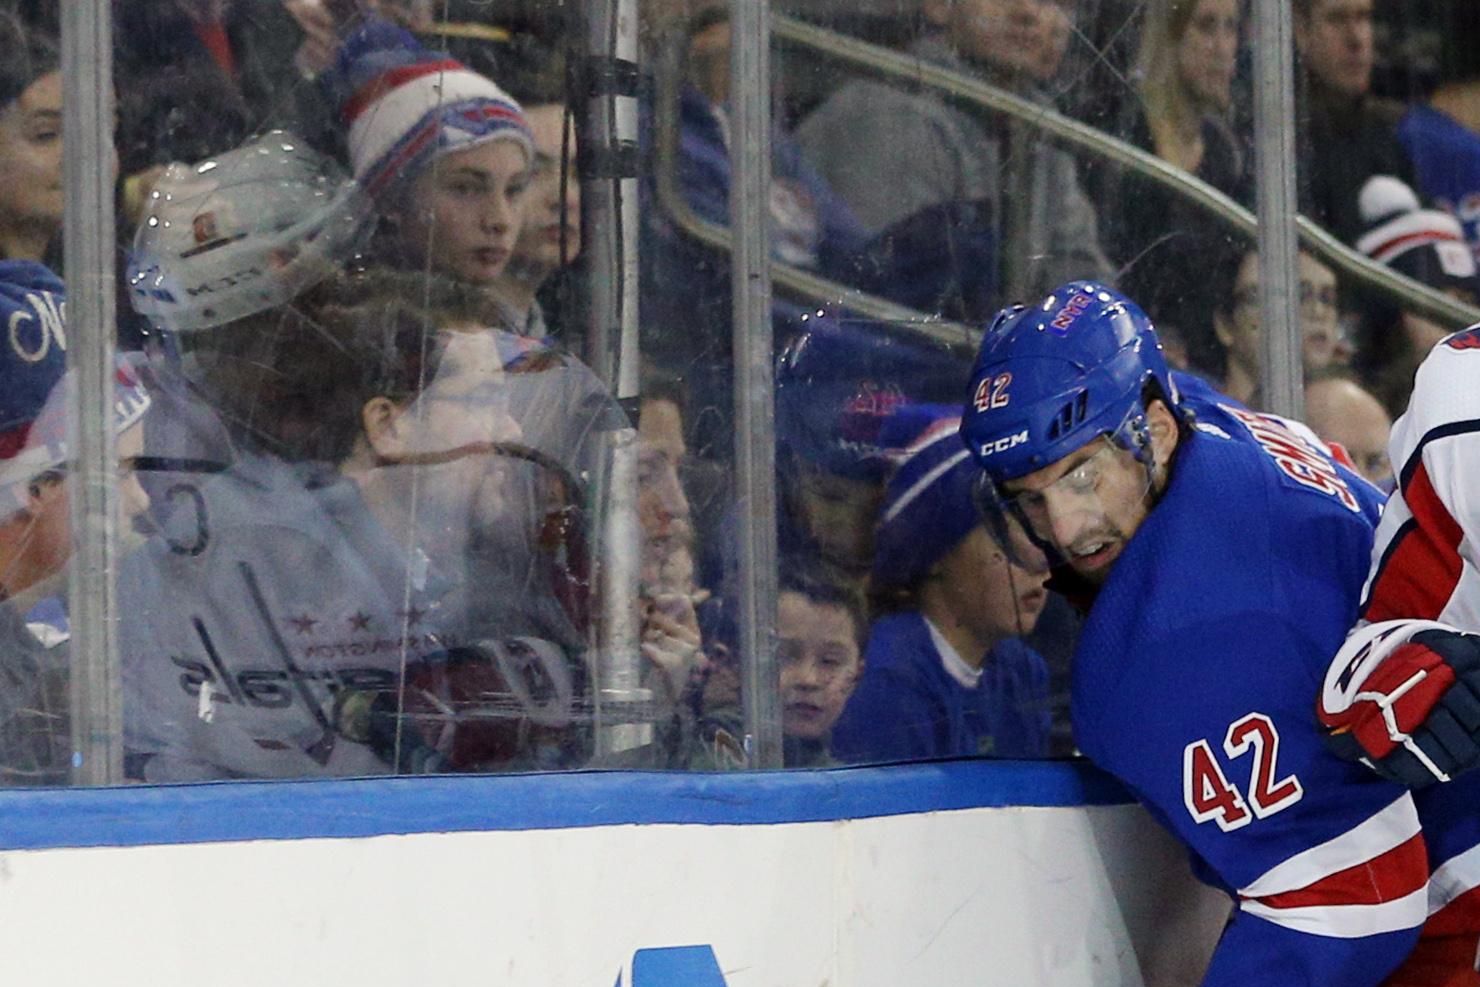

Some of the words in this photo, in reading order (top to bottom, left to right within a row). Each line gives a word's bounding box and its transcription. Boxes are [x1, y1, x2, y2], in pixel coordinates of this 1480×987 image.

[973, 372, 1012, 413] 42
[980, 430, 1028, 456] CCM
[1184, 712, 1304, 833] 42
